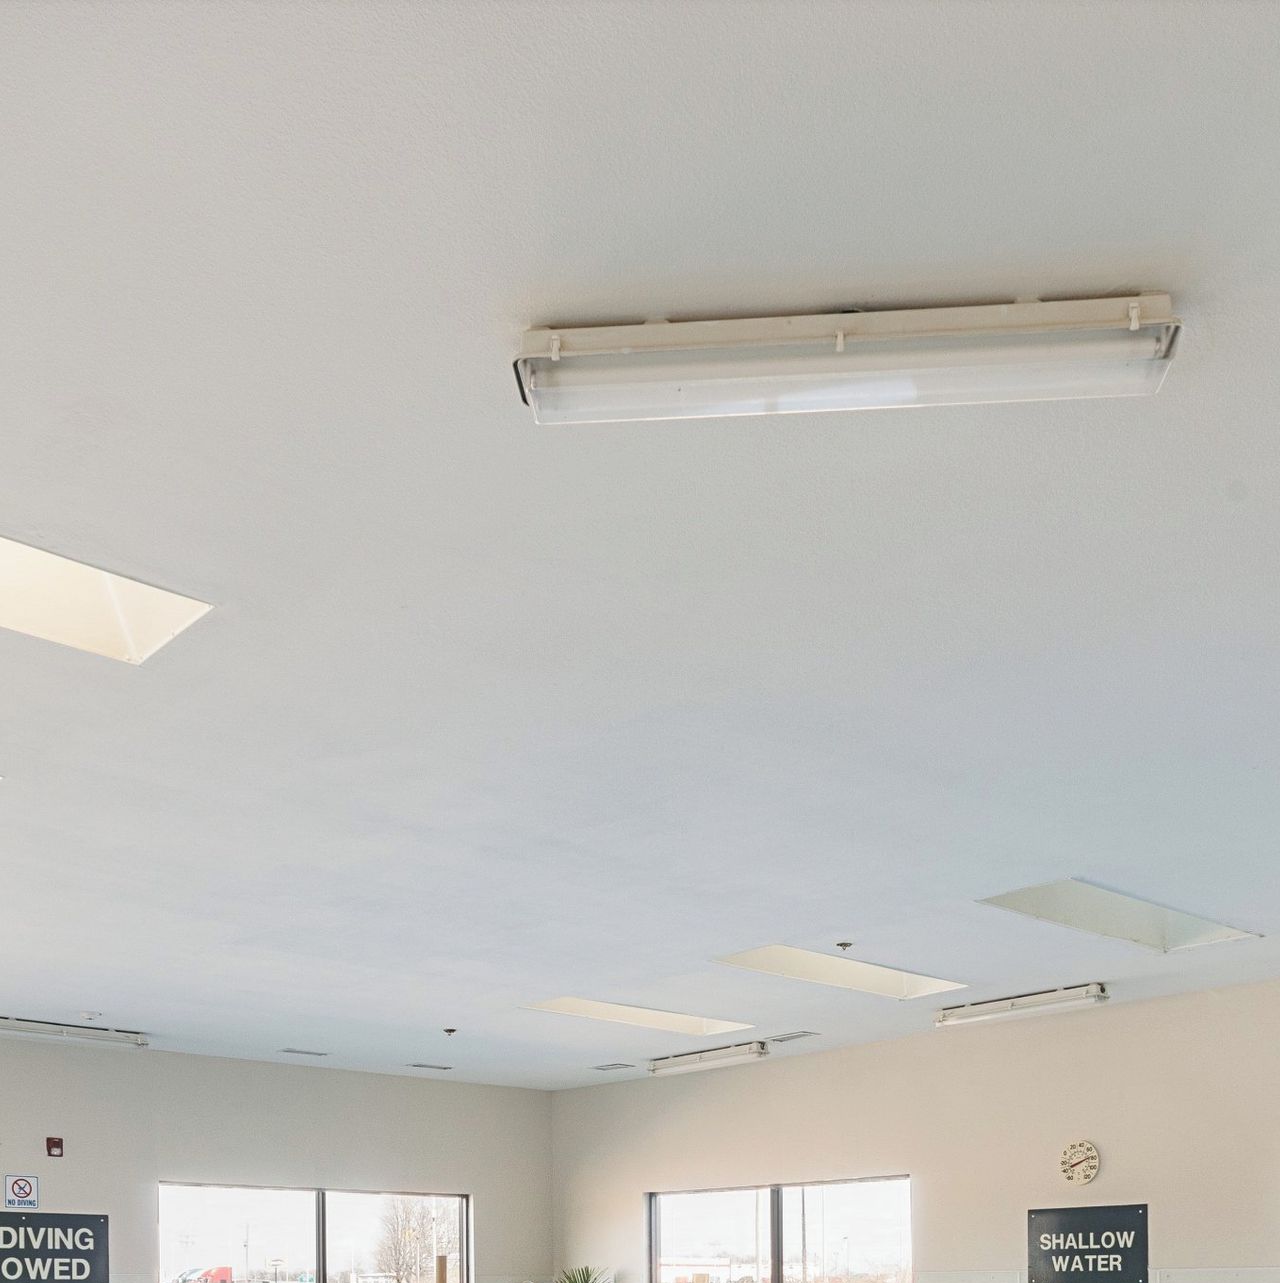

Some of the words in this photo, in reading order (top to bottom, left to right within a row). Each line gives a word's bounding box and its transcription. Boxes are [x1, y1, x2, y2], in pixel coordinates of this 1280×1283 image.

[17, 1199, 37, 1207] DIVING
[1039, 1230, 1136, 1251] SHALLOW
[1051, 1254, 1123, 1272] WATER
